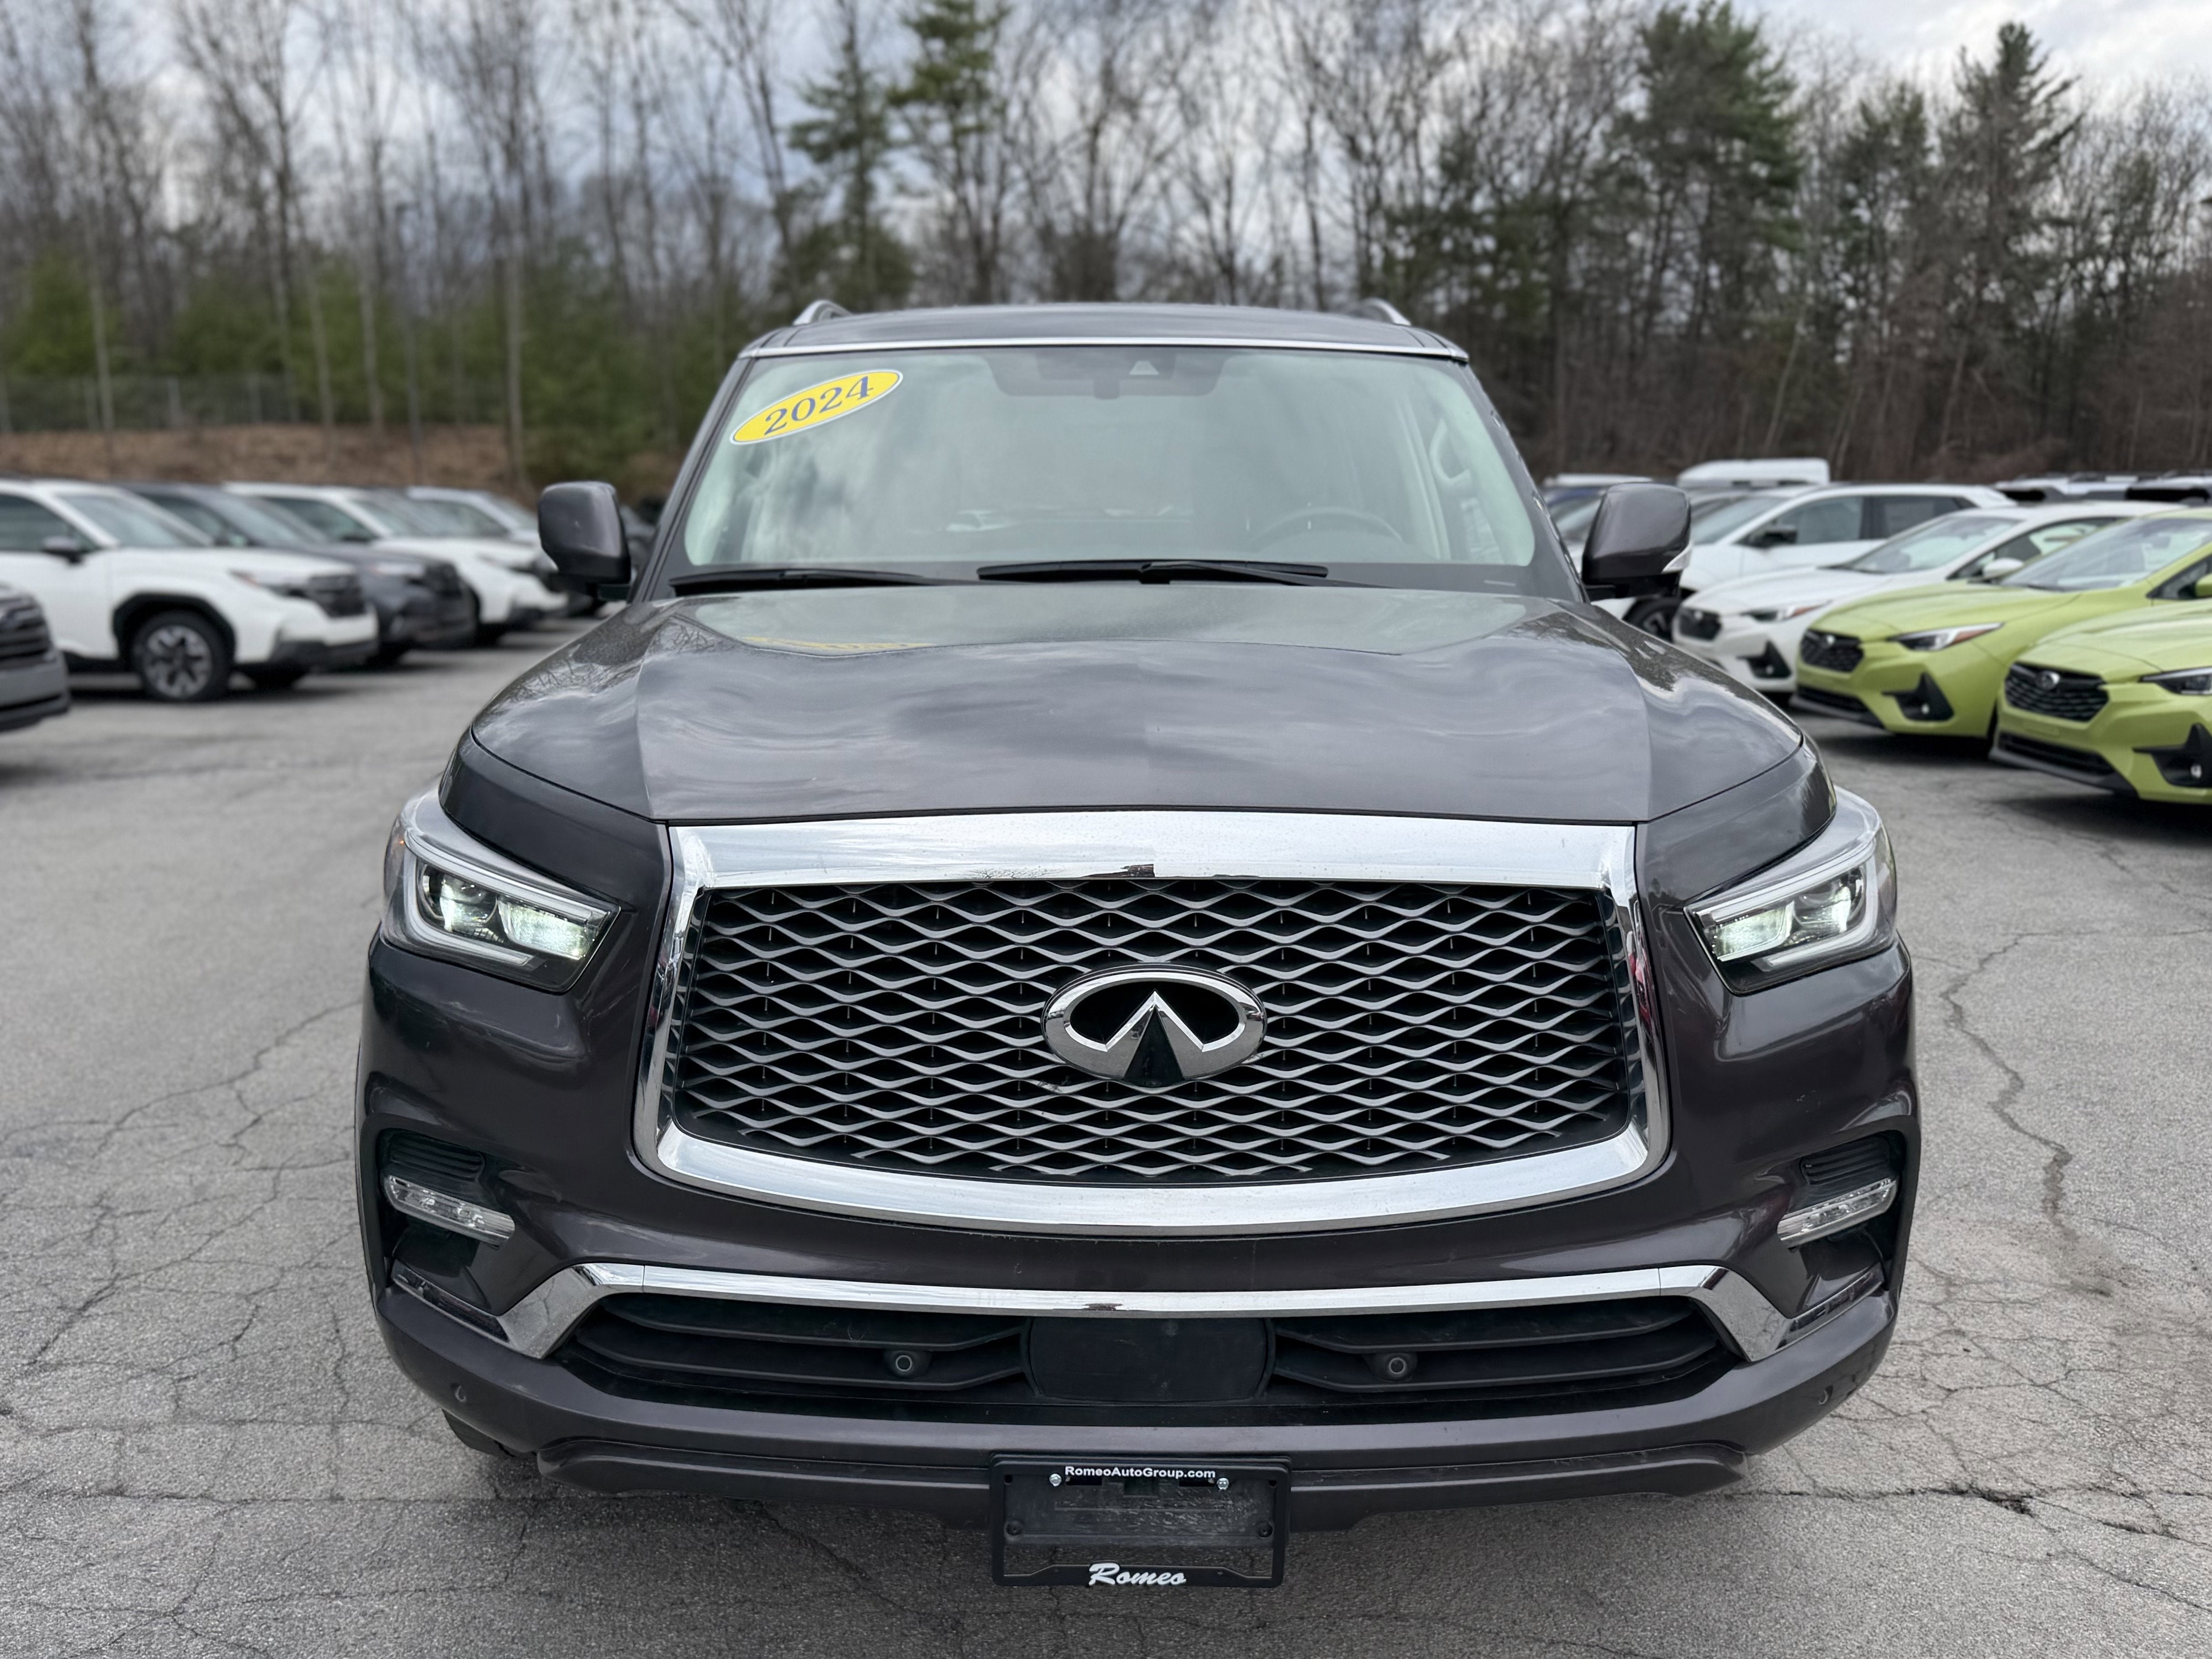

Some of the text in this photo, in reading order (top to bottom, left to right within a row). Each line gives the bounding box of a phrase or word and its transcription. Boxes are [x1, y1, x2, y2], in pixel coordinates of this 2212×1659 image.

[764, 376, 874, 435] 2024
[1064, 1466, 1216, 1479] RomeoAutoGroup.com
[1089, 1563, 1187, 1586] Romeo
